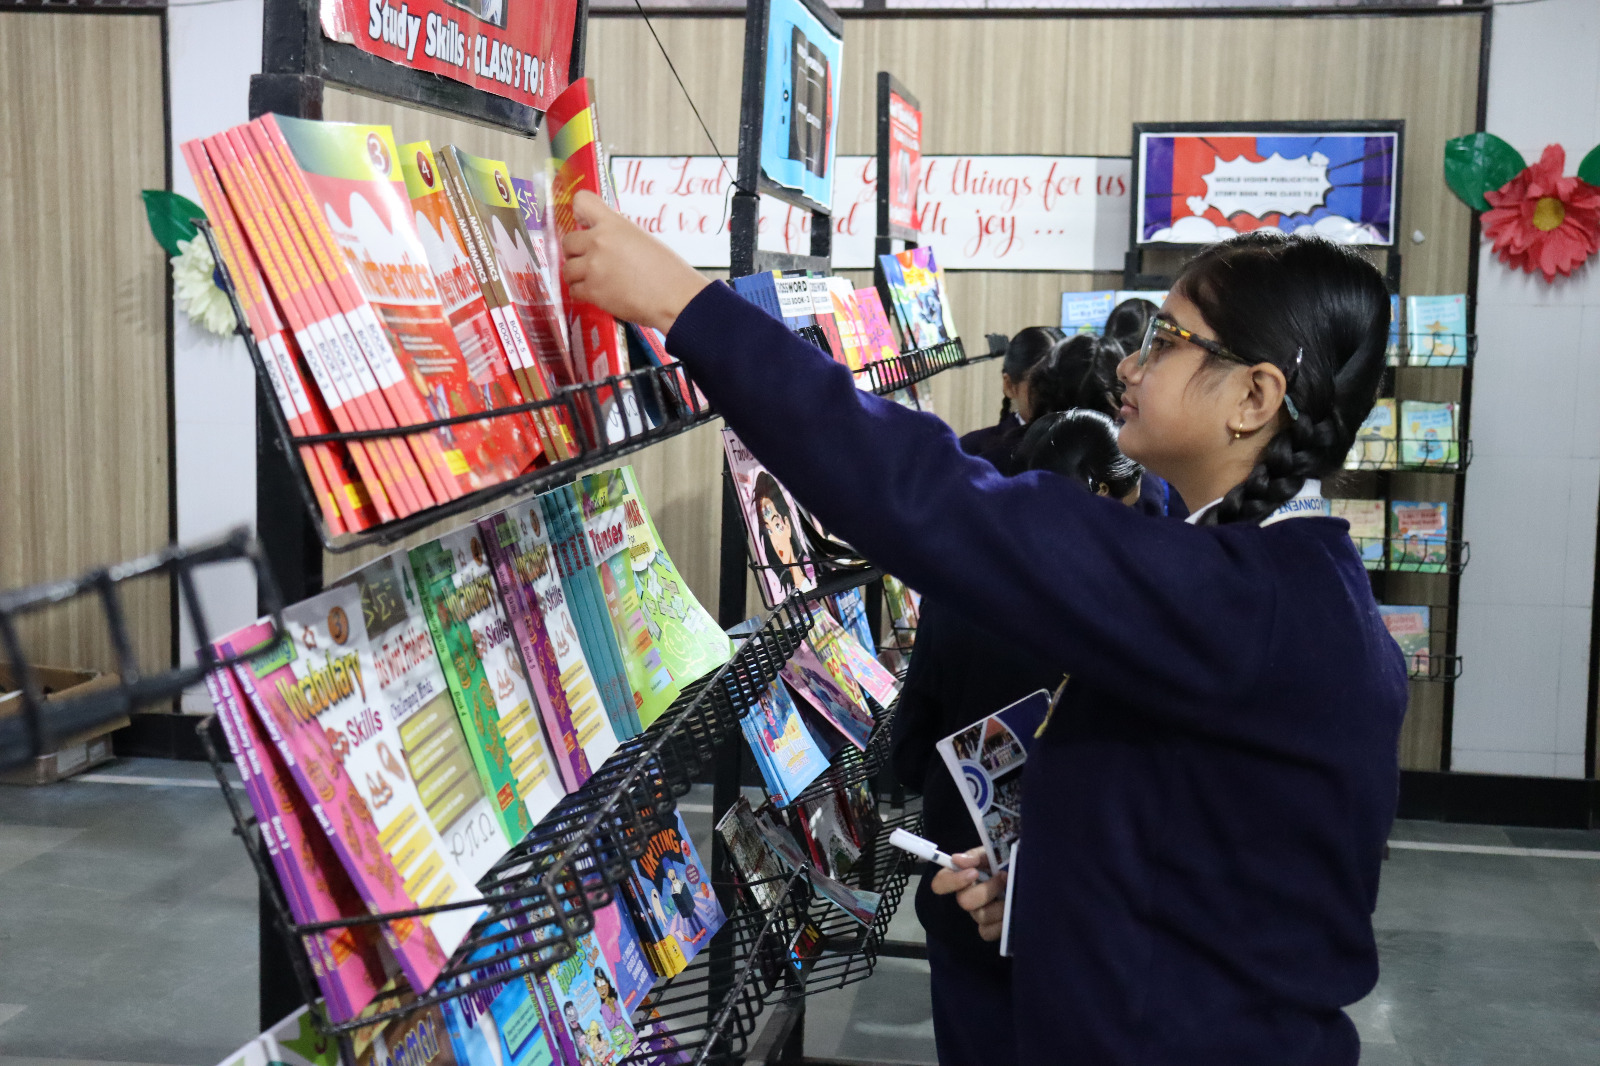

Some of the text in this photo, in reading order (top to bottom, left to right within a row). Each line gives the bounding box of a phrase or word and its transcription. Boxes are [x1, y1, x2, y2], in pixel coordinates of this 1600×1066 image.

[368, 0, 421, 61] Study
[425, 10, 465, 68] Skills
[474, 33, 513, 85] CLASS
[513, 50, 522, 89] 3
[523, 52, 539, 95] TO
[595, 141, 610, 206] MATHEMATIC
[617, 156, 727, 197] The Lord
[951, 159, 1033, 213] things
[1037, 162, 1082, 212] for
[1096, 174, 1127, 197] us
[678, 207, 711, 234] we
[963, 208, 1024, 259] joy
[457, 218, 488, 285] MATHEMATICS
[468, 215, 500, 283] MATHEMATICS
[357, 329, 375, 360] BOOK
[369, 322, 387, 353] BOOK
[498, 321, 512, 346] BOOK
[509, 319, 525, 346] BOOK
[319, 342, 336, 371] BOOK
[330, 338, 346, 367] BOOK
[342, 333, 360, 362] BOOK
[265, 360, 281, 390] BOOK
[278, 353, 295, 384] BOOK
[307, 349, 323, 379] BOOK
[1279, 498, 1321, 515] CONVENT
[568, 534, 583, 571] Tenses
[578, 531, 591, 567] Tenses
[588, 522, 624, 556] Tenses
[506, 595, 518, 615] Skills
[545, 587, 564, 612] Skills
[434, 634, 446, 654] Skills
[485, 620, 510, 649] Skills
[523, 645, 534, 665] Book
[274, 649, 367, 727] Vocabulary
[453, 691, 466, 712] Book
[346, 707, 384, 747] Skills
[235, 753, 250, 782] Skills
[246, 747, 262, 776] Skills
[278, 739, 296, 767] Skills
[312, 803, 331, 830] Book
[543, 984, 558, 1012] RIDDLES
